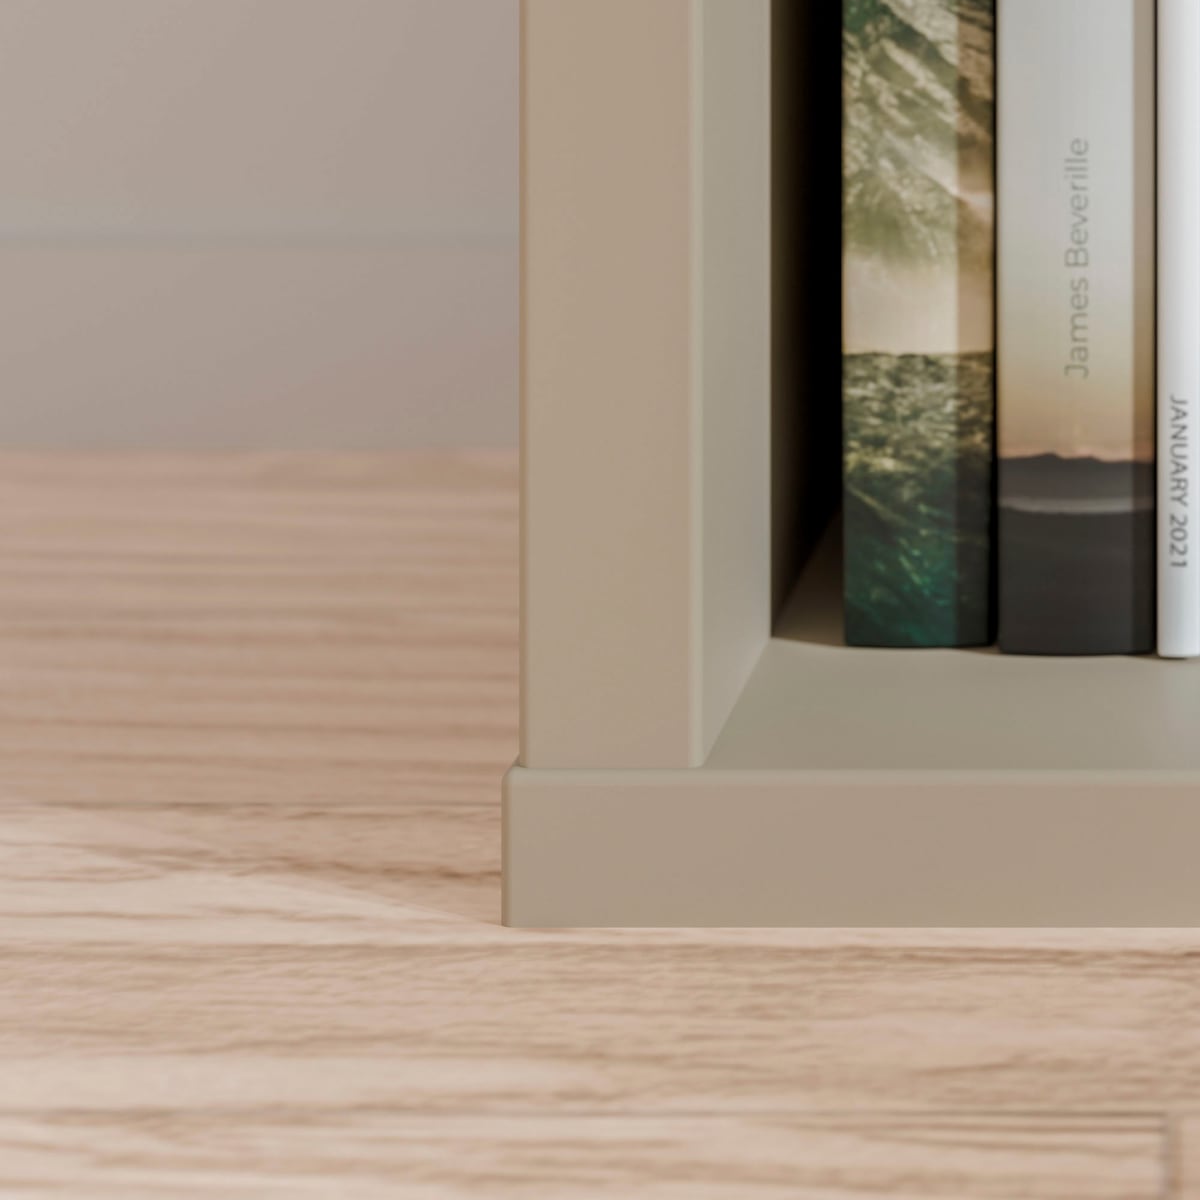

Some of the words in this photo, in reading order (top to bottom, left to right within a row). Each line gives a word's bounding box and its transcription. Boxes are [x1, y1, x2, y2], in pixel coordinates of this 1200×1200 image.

[1064, 136, 1090, 268] Beverille
[1064, 276, 1090, 378] James
[1169, 394, 1189, 507] JANUARY
[1169, 514, 1189, 569] 2021
